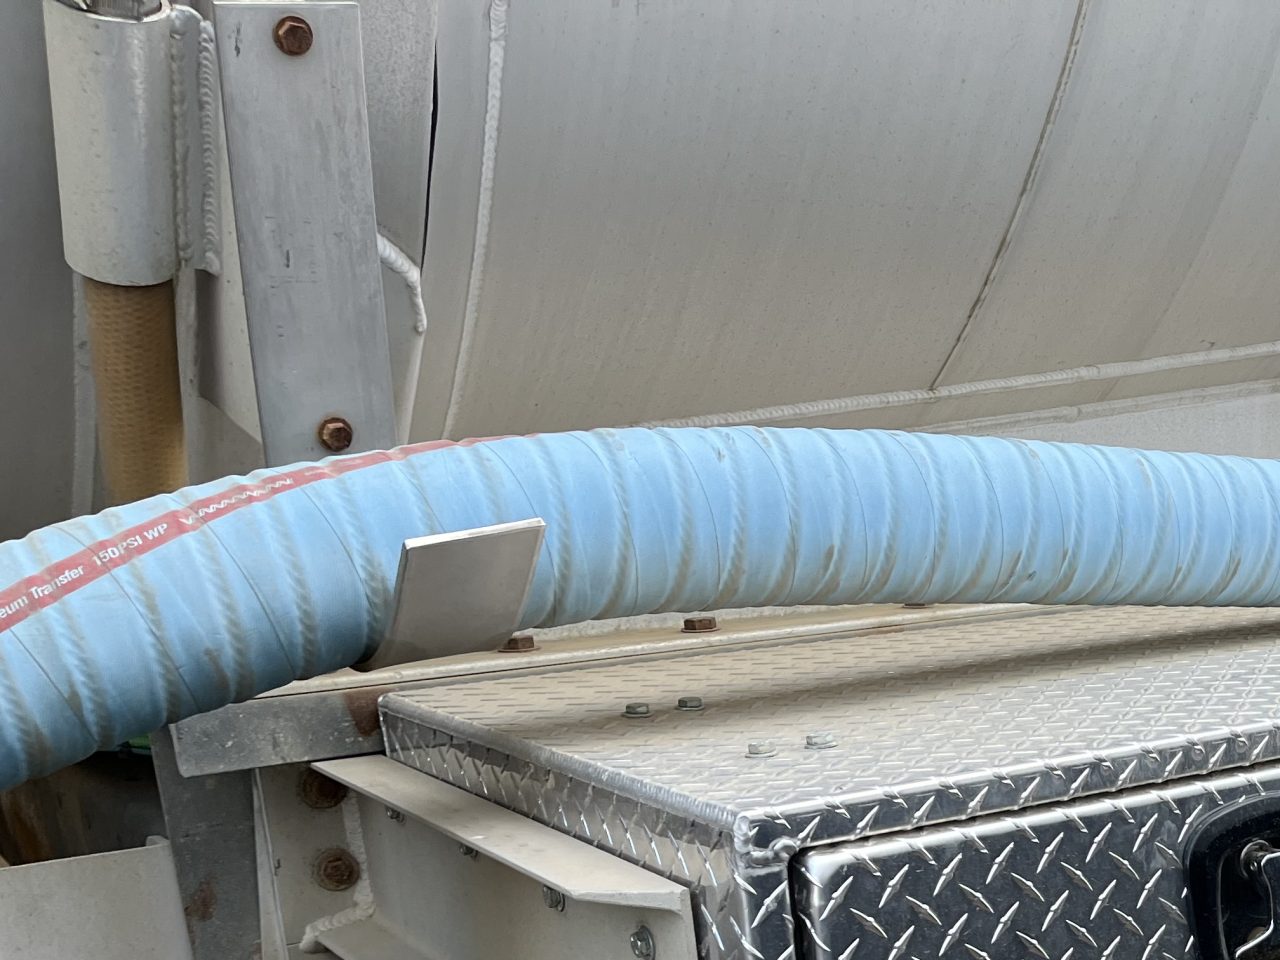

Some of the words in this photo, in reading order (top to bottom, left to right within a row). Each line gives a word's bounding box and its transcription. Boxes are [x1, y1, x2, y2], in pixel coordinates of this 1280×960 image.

[29, 565, 85, 599] Transfer
[91, 535, 143, 566] 150PSI
[143, 523, 169, 541] WP
